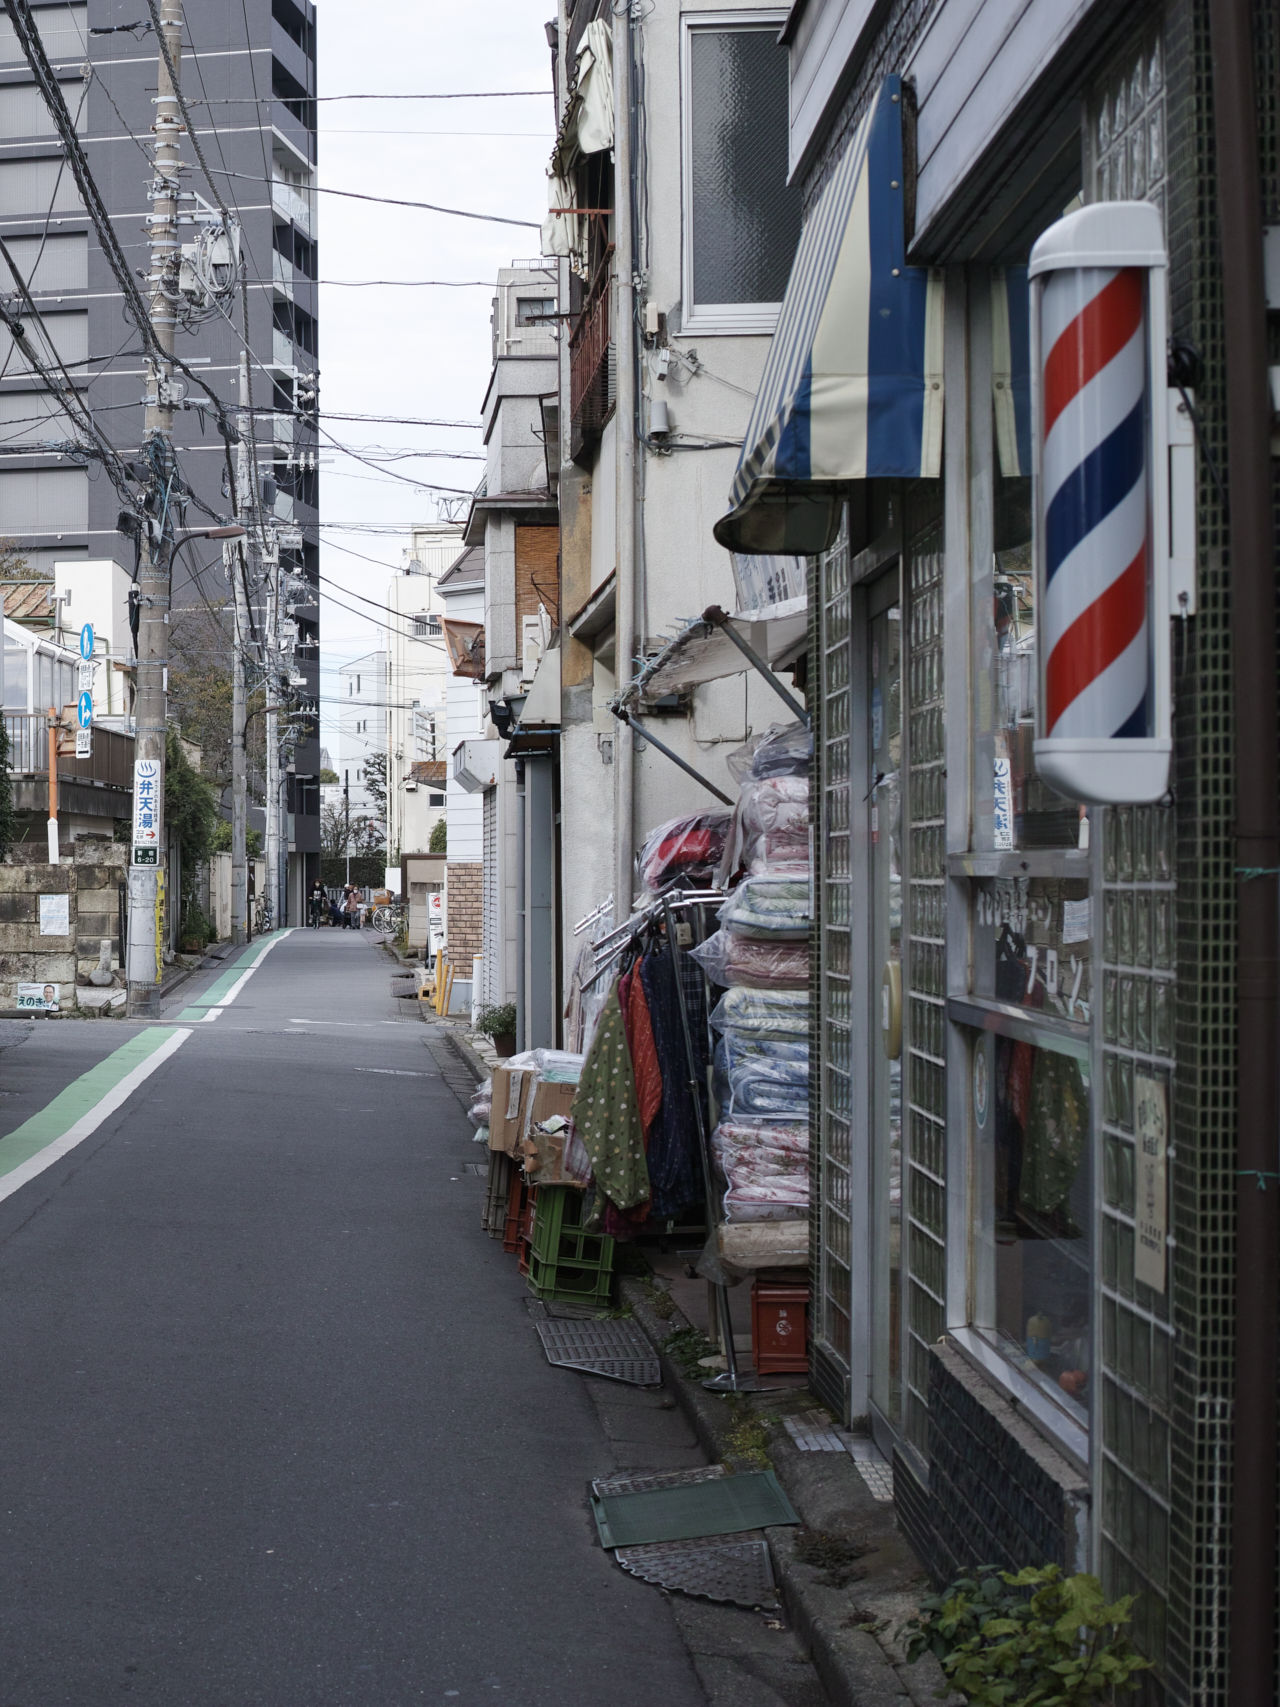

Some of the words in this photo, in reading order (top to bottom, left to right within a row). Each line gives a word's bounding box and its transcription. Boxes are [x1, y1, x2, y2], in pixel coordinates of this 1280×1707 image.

[139, 780, 153, 828] 弁天湯
[18, 996, 43, 1008] えのき
